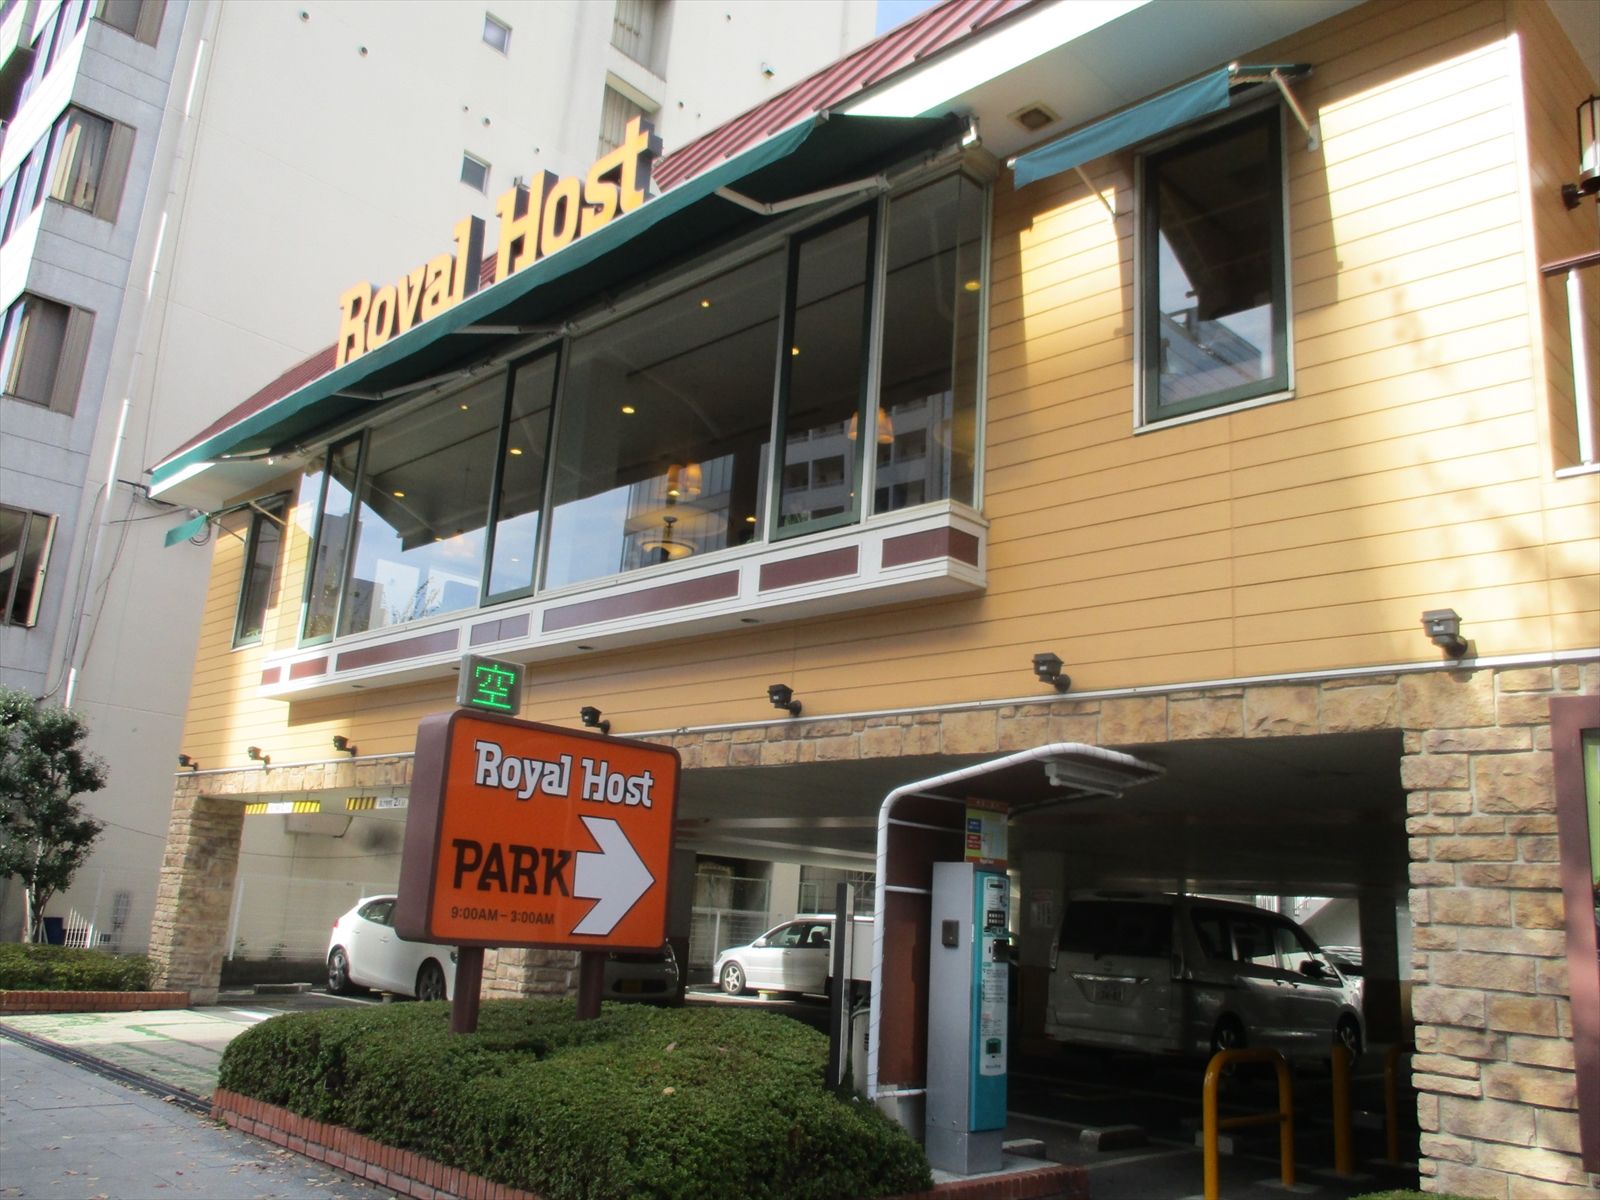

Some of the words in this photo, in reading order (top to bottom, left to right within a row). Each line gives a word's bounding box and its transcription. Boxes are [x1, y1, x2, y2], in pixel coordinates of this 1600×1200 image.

[336, 214, 476, 369] Royal
[495, 115, 651, 281] Host
[472, 664, 515, 709] 空
[474, 739, 573, 800] Royal
[581, 757, 654, 808] Host
[452, 838, 572, 898] PARK
[451, 905, 498, 922] 9:00AM
[511, 911, 554, 925] 3:00AM
